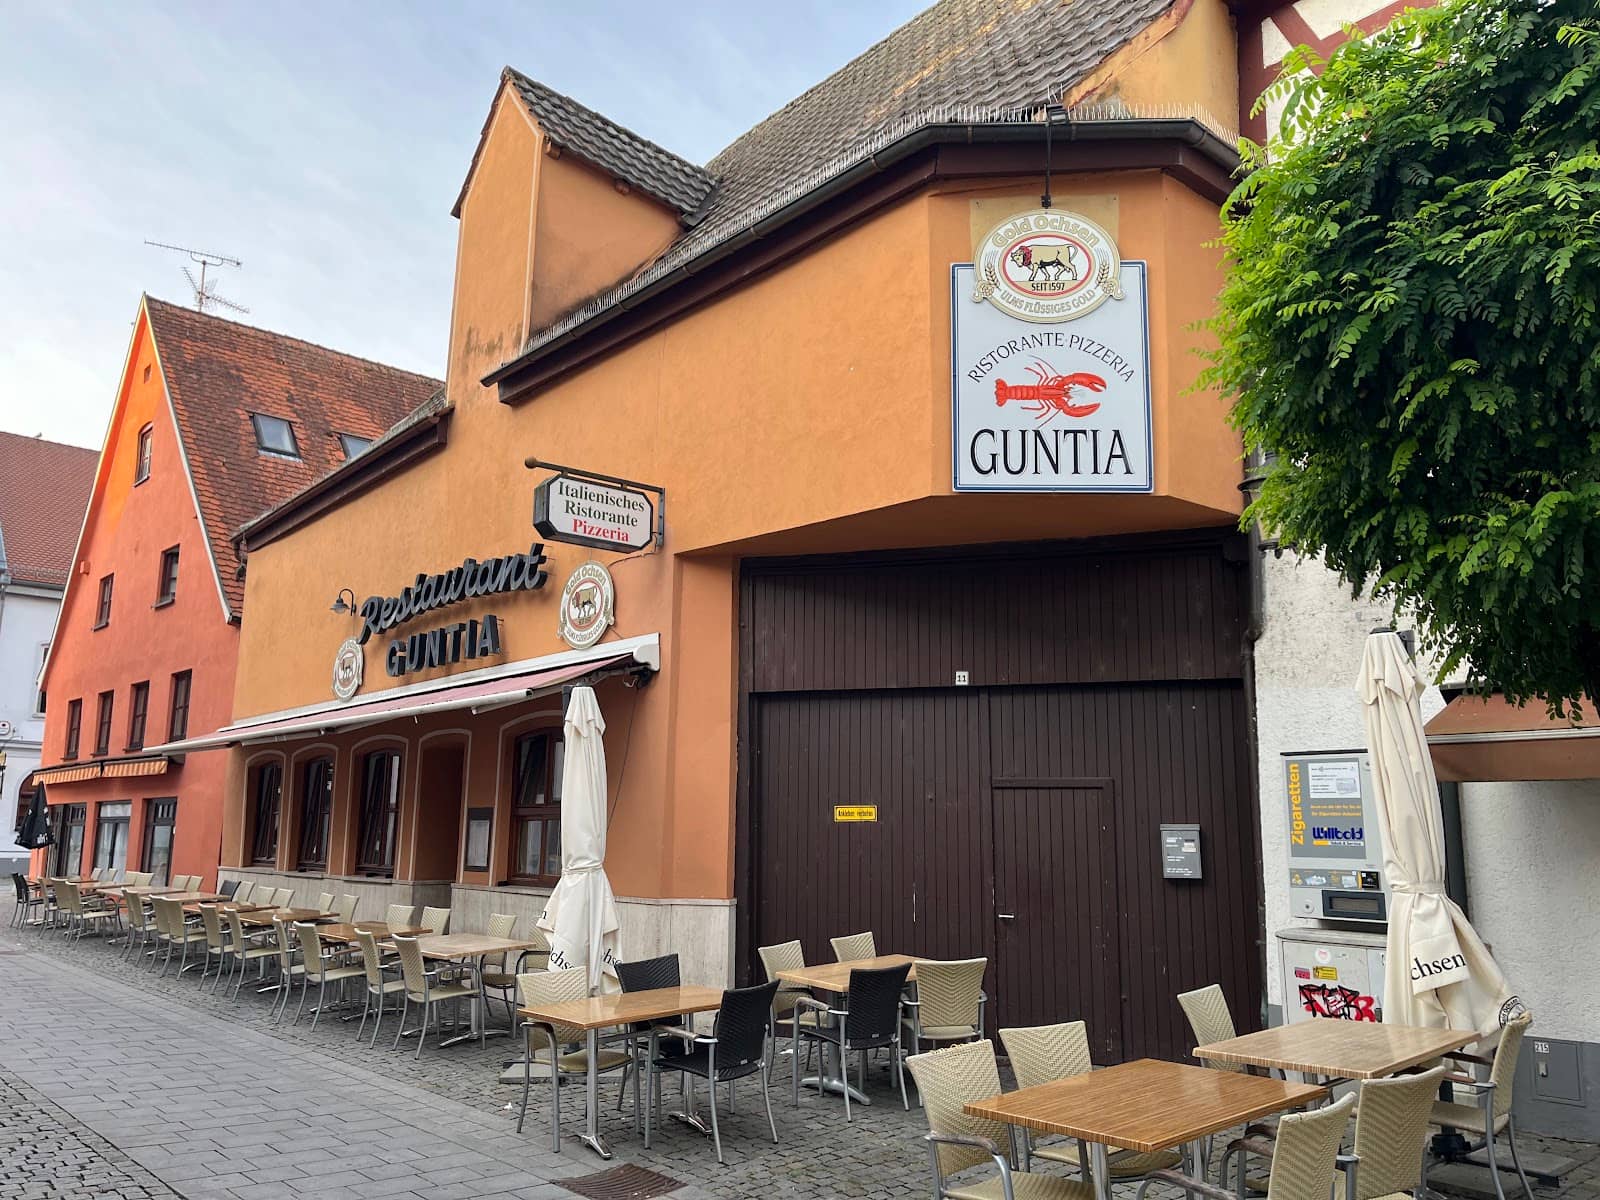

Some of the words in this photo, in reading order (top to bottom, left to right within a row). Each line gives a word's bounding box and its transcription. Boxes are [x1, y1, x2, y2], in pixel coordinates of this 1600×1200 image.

[992, 218, 1032, 247] Gold
[1034, 215, 1099, 248] Ochsen
[1000, 290, 1024, 308] ULMS
[1023, 302, 1072, 314] FLÜSSIGES
[1072, 289, 1096, 309] GOLD
[1031, 282, 1048, 291] SEIT
[1049, 282, 1065, 291] 1597
[967, 332, 1065, 383] RISTORANTE
[1069, 334, 1136, 382] PIZZERIA
[970, 428, 1134, 475] GUNTIA
[558, 481, 645, 512] Italienisches
[564, 500, 638, 527] Ristorante
[572, 518, 629, 542] Pizzeria
[358, 543, 548, 644] Restaurant
[566, 570, 582, 595] Gold
[581, 565, 607, 586] Ochsen
[386, 614, 500, 677] GUNTIA
[1289, 763, 1306, 845] Zigaretten
